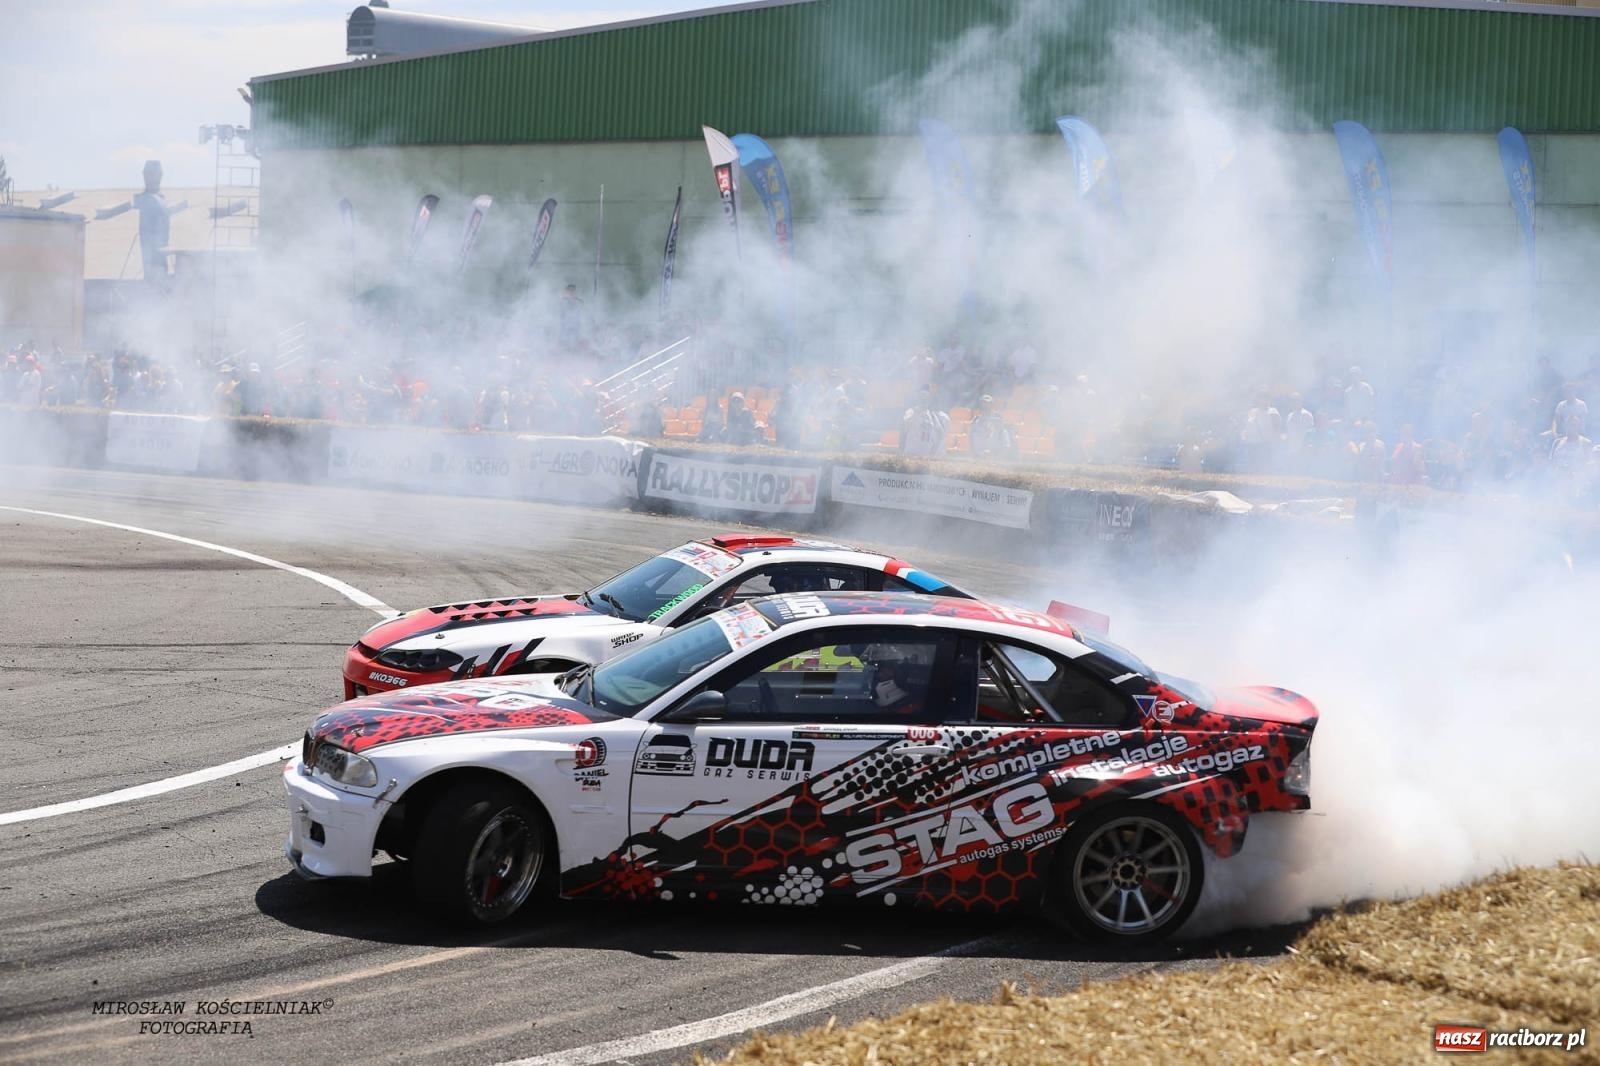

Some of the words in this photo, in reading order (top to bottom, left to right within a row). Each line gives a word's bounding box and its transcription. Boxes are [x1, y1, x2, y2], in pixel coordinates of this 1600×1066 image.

[652, 462, 791, 505] RALLYSHOP
[612, 633, 644, 649] SHOP
[705, 737, 816, 772] DUDA
[961, 730, 1122, 785] kompletne
[1048, 736, 1189, 787] instalacje
[1152, 743, 1265, 779] autogaz
[703, 767, 733, 778] GAZ
[747, 769, 811, 783] SERWIS
[845, 783, 1056, 884] STAG
[959, 843, 1010, 864] autogas
[1011, 828, 1063, 850] systems
